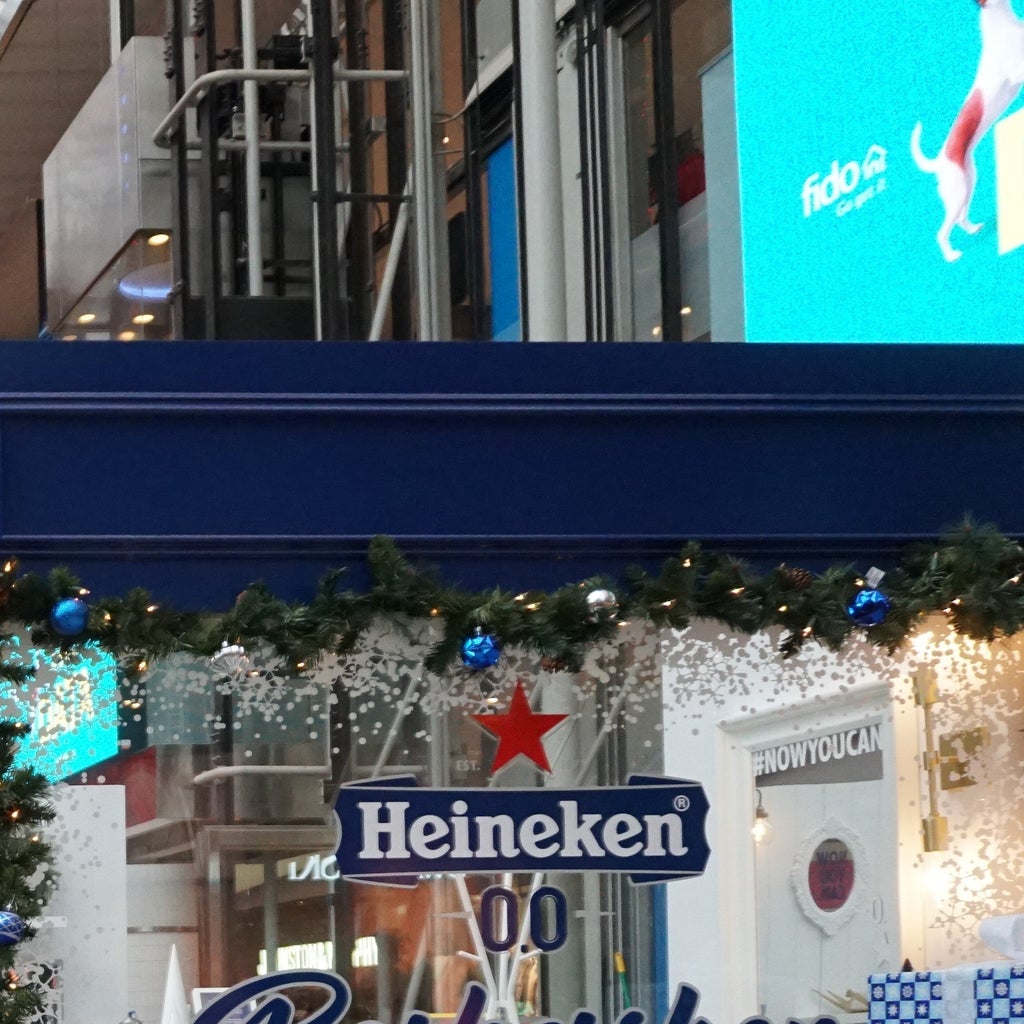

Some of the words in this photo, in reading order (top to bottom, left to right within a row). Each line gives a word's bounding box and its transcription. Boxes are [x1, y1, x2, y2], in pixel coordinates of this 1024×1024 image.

[802, 160, 860, 218] fido
[754, 724, 883, 776] #NOWYOUCAN
[479, 885, 568, 953] 0.0
